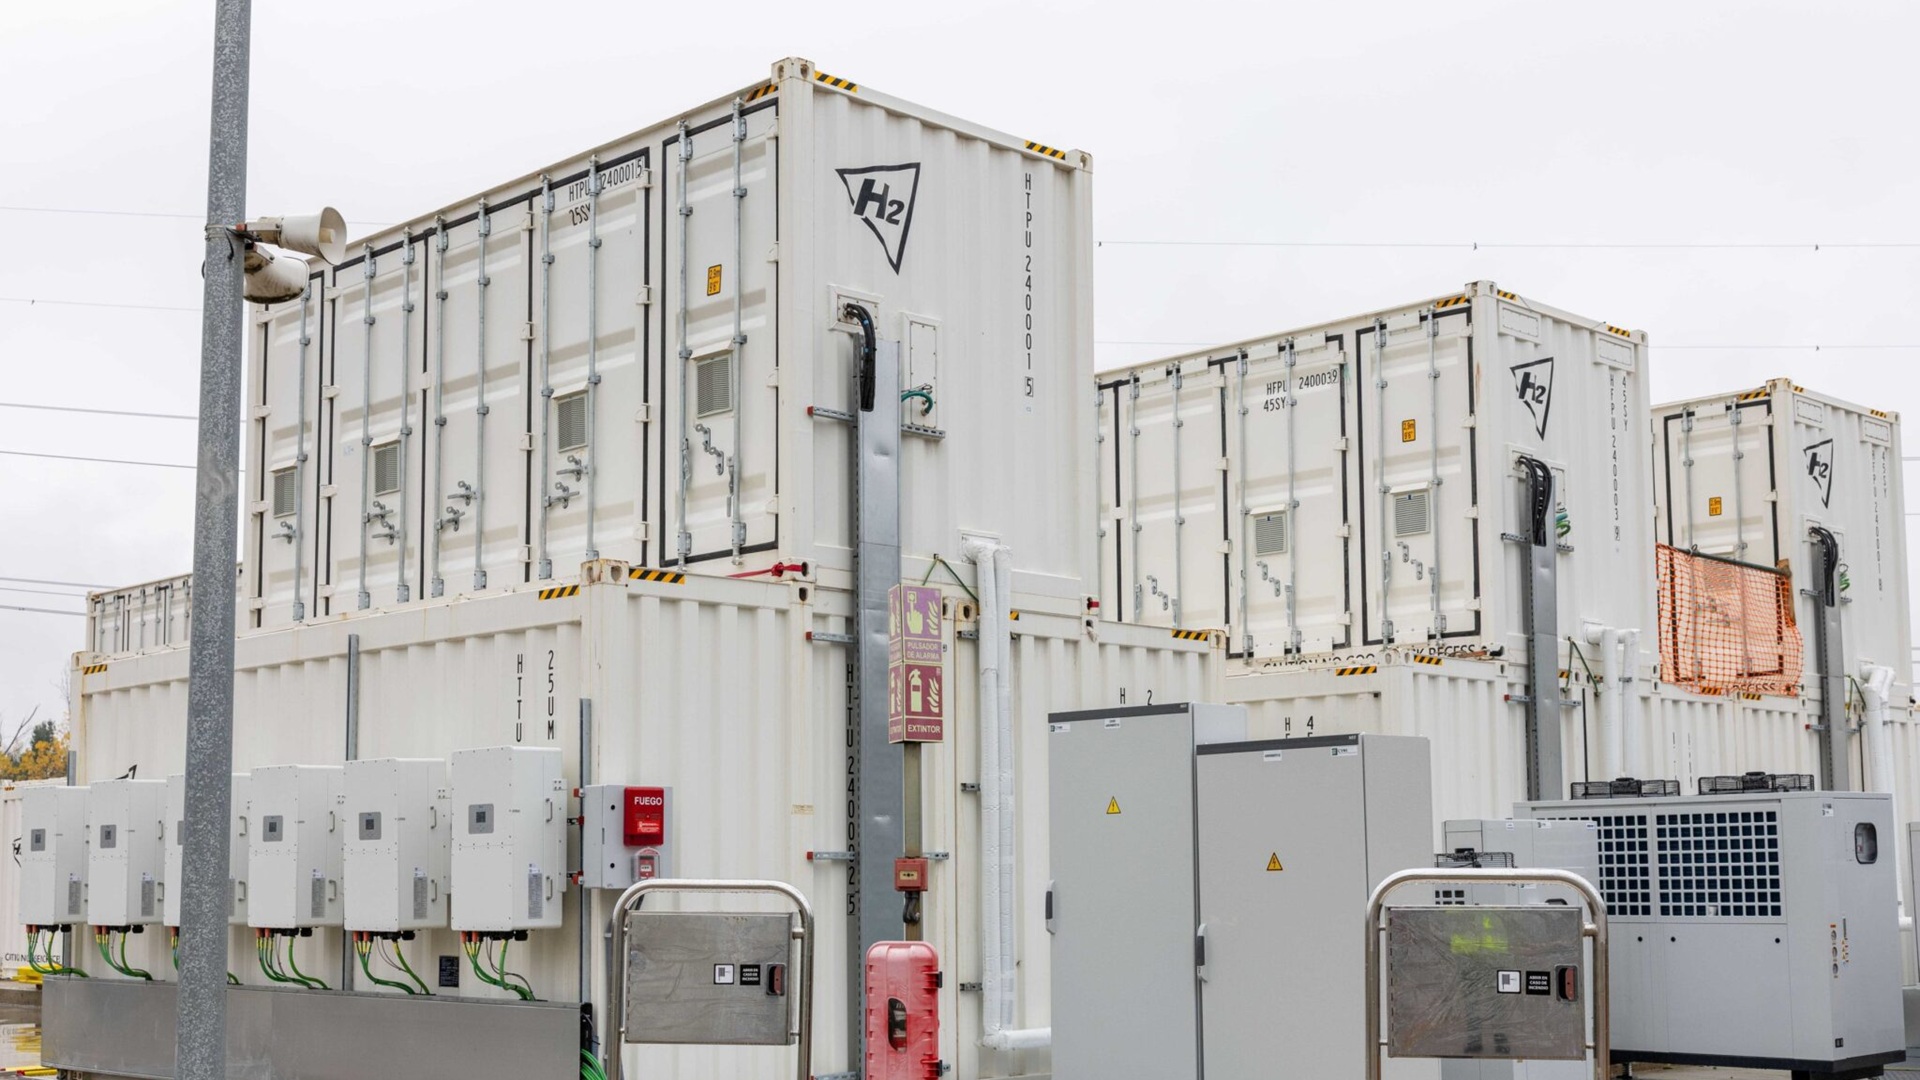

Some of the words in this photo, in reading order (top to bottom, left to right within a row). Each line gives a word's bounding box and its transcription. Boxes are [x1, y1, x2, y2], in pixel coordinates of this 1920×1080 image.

[853, 178, 905, 226] H2
[1518, 371, 1547, 405] H2
[1263, 396, 1287, 413] 45SY
[907, 724, 941, 734] EXTINTOR
[634, 796, 662, 806] FUEGO
